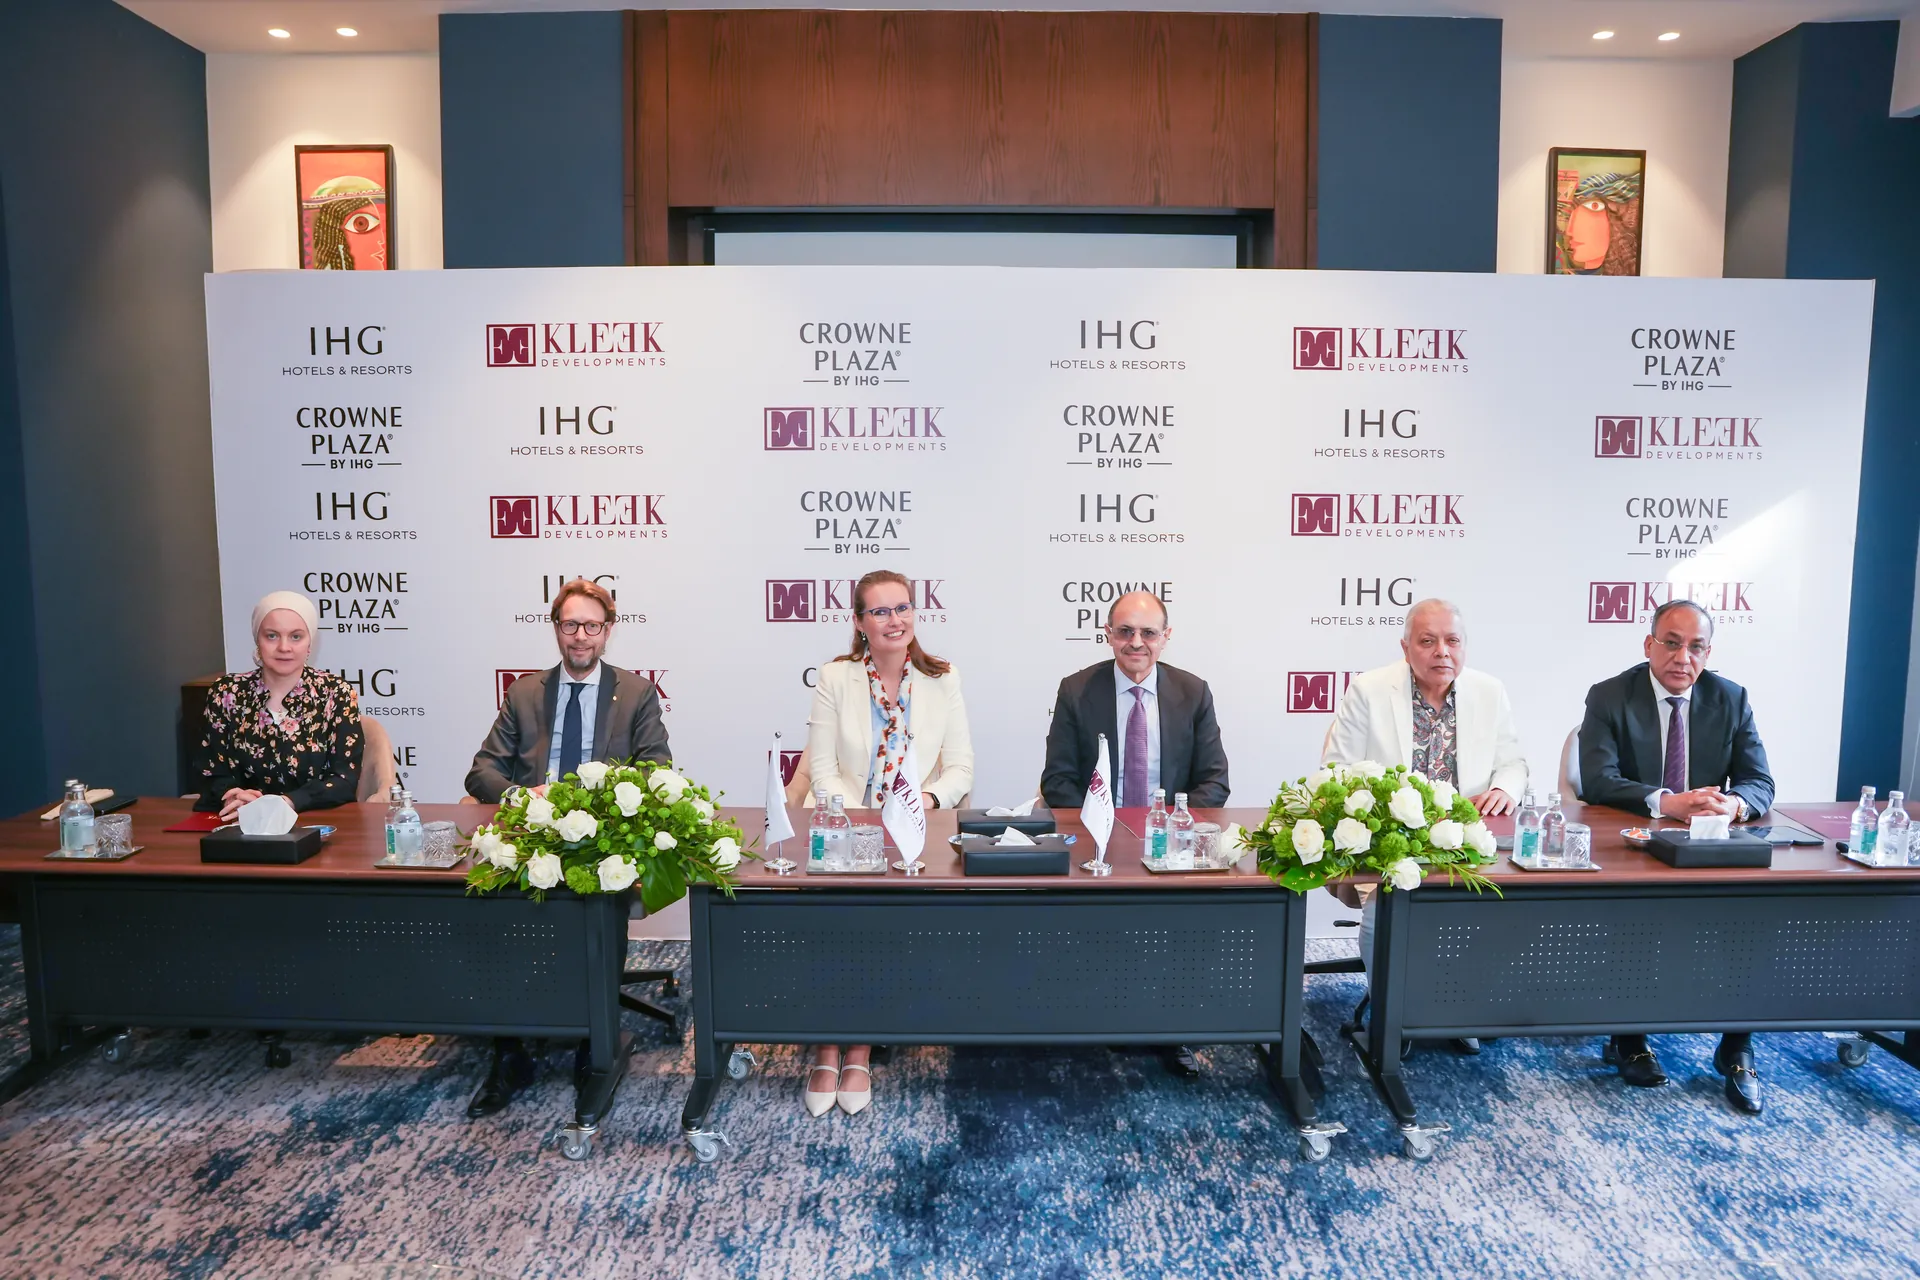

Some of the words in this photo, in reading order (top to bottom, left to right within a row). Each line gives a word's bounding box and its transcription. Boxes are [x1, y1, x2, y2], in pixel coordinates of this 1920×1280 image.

[800, 323, 911, 344] CROWNE
[1081, 320, 1155, 349] IHG
[311, 326, 384, 355] IHG
[1631, 328, 1735, 350] CROWNE
[541, 358, 665, 367] DEVELOPMENTS
[1050, 360, 1104, 369] HOTELS
[1110, 361, 1117, 369] &
[1122, 361, 1185, 370] RESORTS
[283, 367, 334, 375] HOTELS
[339, 366, 346, 375] &
[351, 366, 412, 375] RESORTS
[1348, 363, 1468, 373] DEVELOPMENTS
[834, 376, 850, 386] BY
[855, 376, 879, 386] IHG
[1662, 381, 1677, 390] BY
[1682, 381, 1703, 391] IHG
[297, 407, 402, 428] CROWNE
[540, 406, 616, 435] IHG
[1064, 405, 1174, 426] CROWNE
[1345, 409, 1416, 438] IHG
[511, 446, 564, 455] HOTELS
[568, 446, 576, 455] &
[581, 446, 643, 454] RESORTS
[820, 443, 946, 451] DEVELOPMENTS
[1315, 448, 1367, 457] HOTELS
[1372, 449, 1379, 457] &
[1384, 449, 1445, 458] RESORTS
[1646, 451, 1762, 460] DEVELOPMENTS
[331, 459, 345, 469] BY
[351, 459, 373, 469] IHG
[1098, 458, 1113, 468] BY
[1119, 458, 1142, 468] IHG
[316, 492, 389, 520] IHG
[801, 491, 911, 512] CROWNE
[1081, 494, 1154, 523] IHG
[1626, 498, 1728, 518] CROWNE
[290, 531, 340, 540] HOTELS
[345, 531, 352, 540] &
[357, 531, 417, 540] RESORTS
[545, 530, 667, 538] DEVELOPMENTS
[1345, 529, 1464, 537] DEVELOPMENTS
[1050, 534, 1104, 542] HOTELS
[1109, 534, 1116, 542] &
[1121, 534, 1184, 543] RESORTS
[835, 544, 851, 553] BY
[856, 544, 880, 553] IHG
[1656, 549, 1670, 558] BY
[1675, 549, 1696, 558] IHG
[304, 572, 408, 593] CROWNE
[1341, 578, 1414, 608] IHG
[1311, 617, 1363, 625] HOTELS
[1368, 617, 1375, 625] &
[338, 623, 352, 633] BY
[358, 624, 380, 633] IHG
[341, 668, 396, 697] HG
[366, 707, 425, 716] RESORTS
